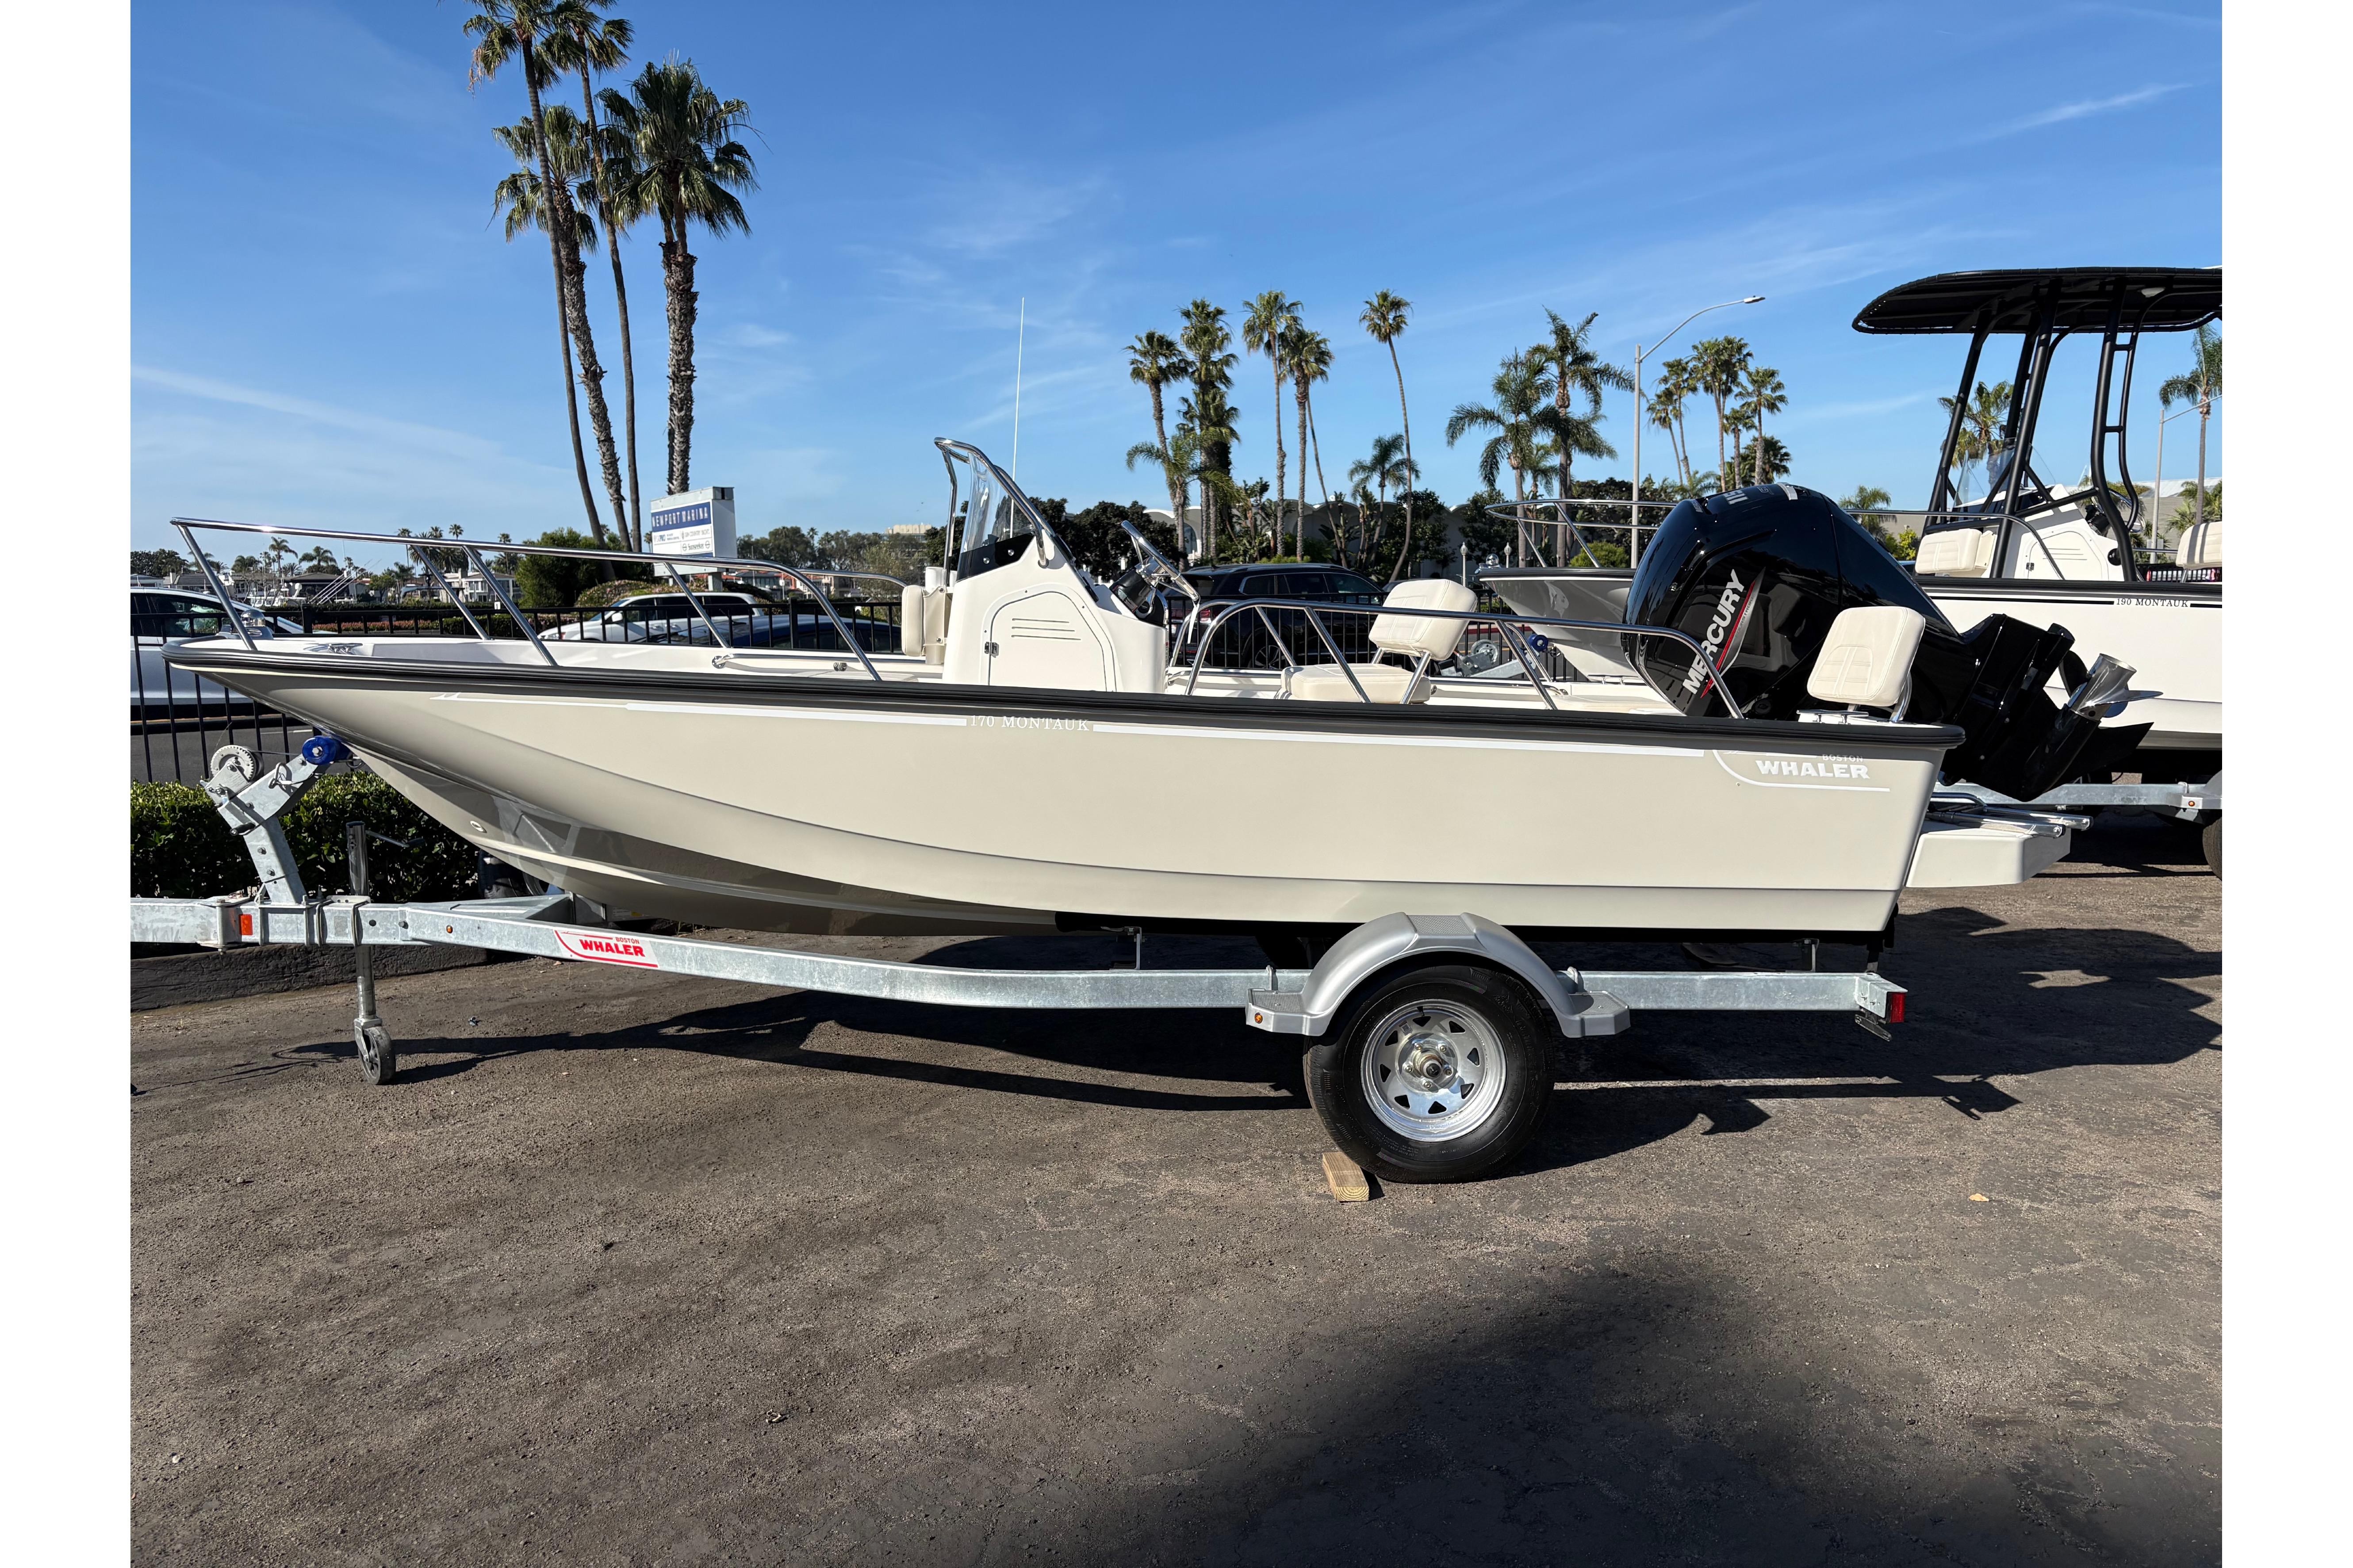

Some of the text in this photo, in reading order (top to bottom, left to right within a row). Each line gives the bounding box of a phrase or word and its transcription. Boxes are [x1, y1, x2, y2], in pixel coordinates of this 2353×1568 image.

[652, 507, 708, 527] NEWPORT MARINA
[2135, 599, 2188, 608] MONTAUK
[1682, 569, 1744, 694] MERCURY
[970, 715, 1089, 731] 170 MONTAUK
[1822, 753, 1863, 762] BOSTON
[1755, 760, 1870, 779] WHALER
[579, 939, 645, 957] WHALER
